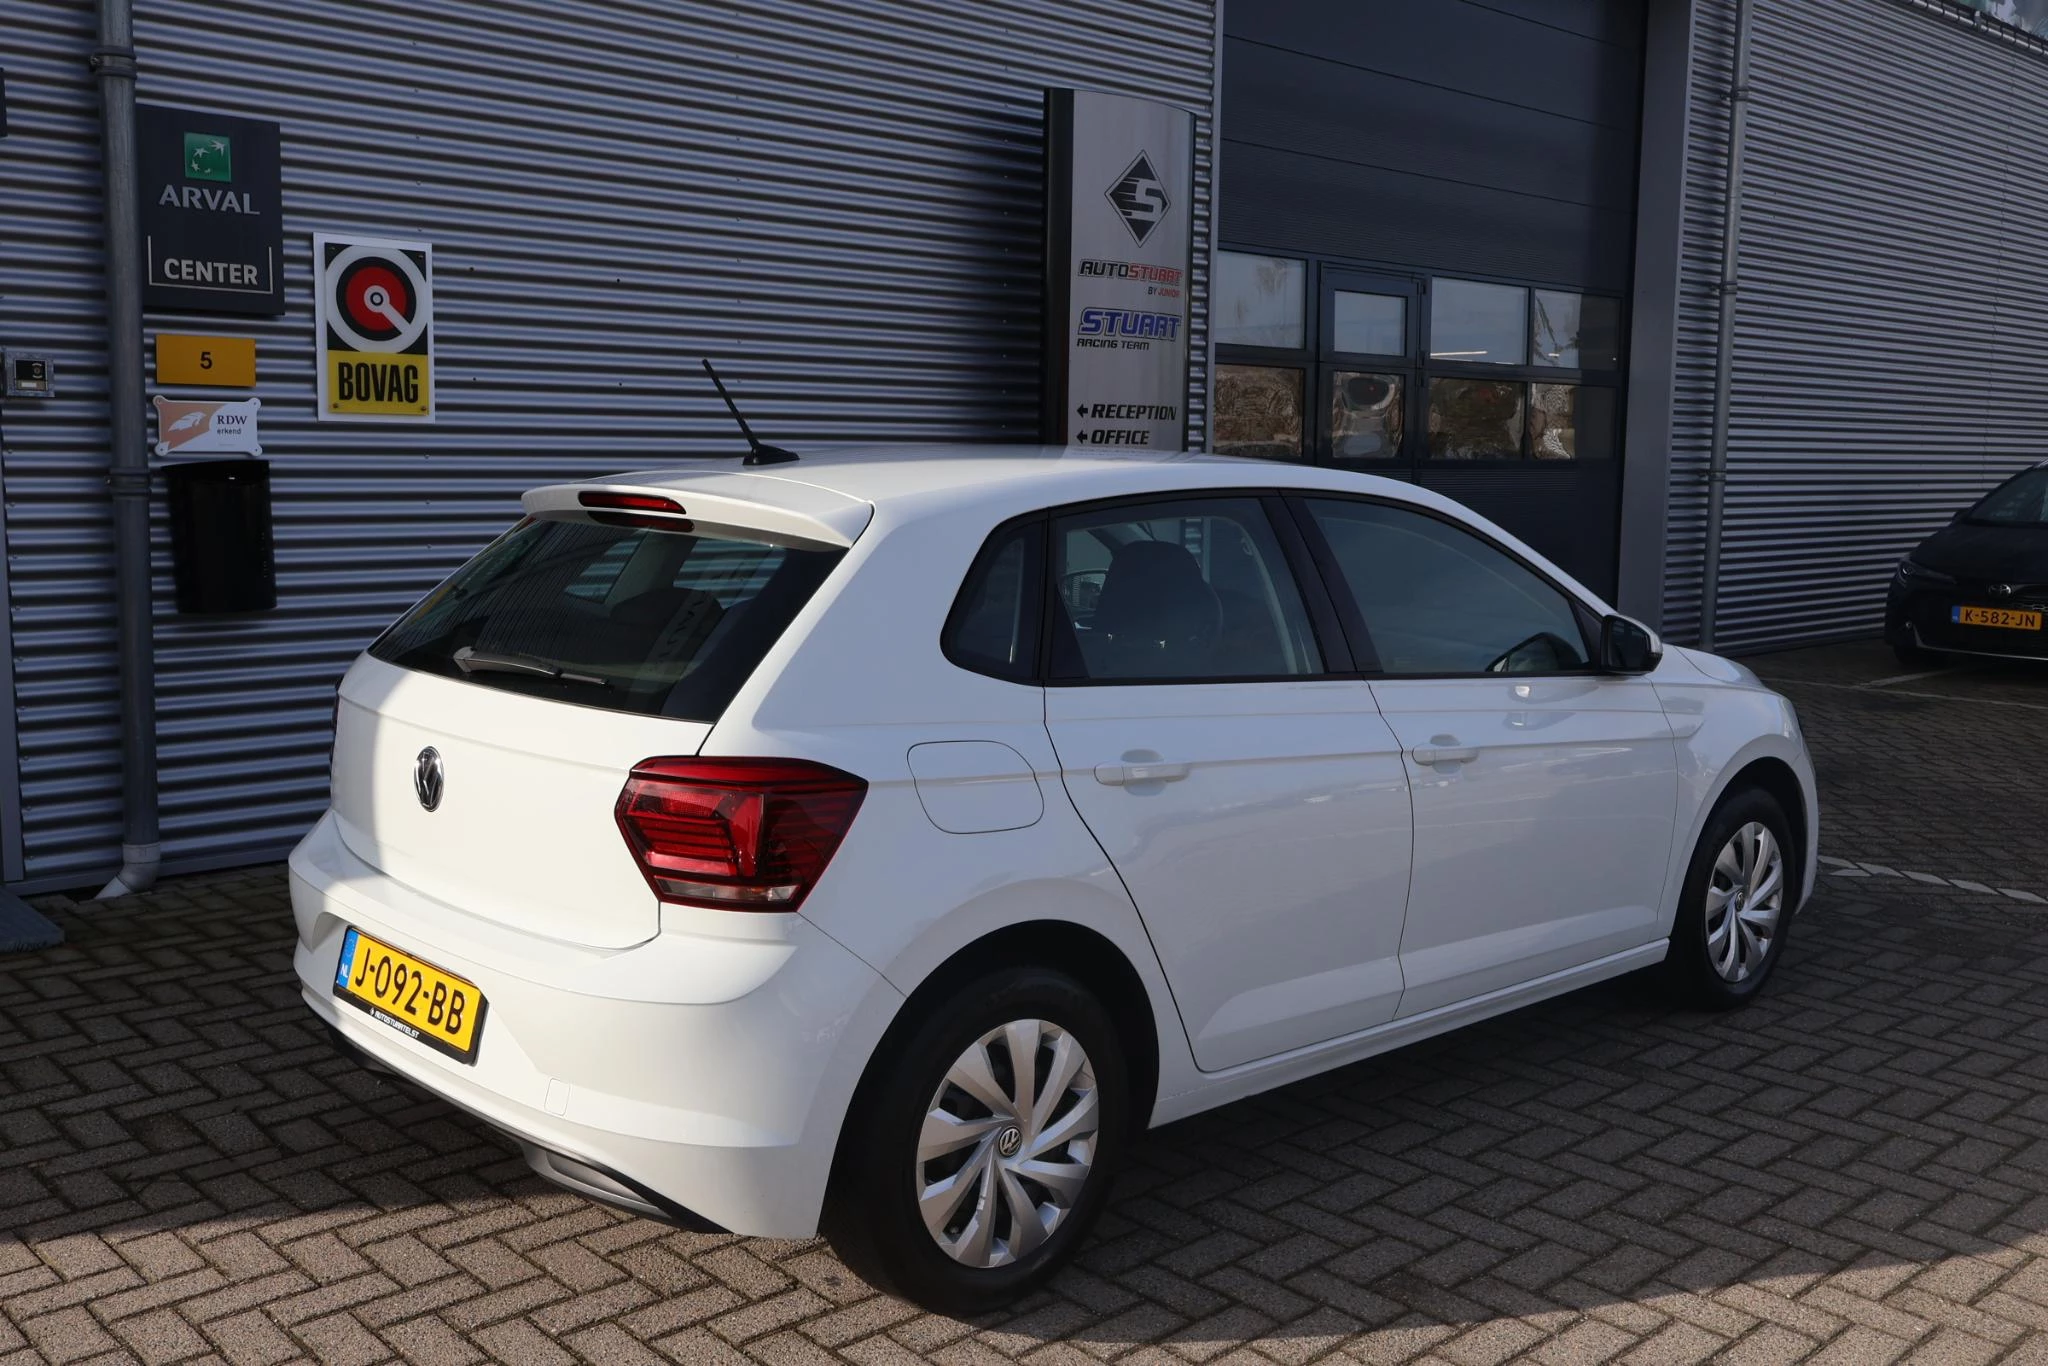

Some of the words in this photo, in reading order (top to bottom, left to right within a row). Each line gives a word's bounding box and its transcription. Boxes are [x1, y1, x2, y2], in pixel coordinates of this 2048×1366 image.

[158, 184, 260, 215] ARVAL
[163, 258, 258, 286] CENTER
[1080, 260, 1182, 283] AUTOSTUART
[1147, 287, 1158, 296] BY
[1079, 308, 1181, 341] STUART
[1077, 339, 1118, 350] RACING
[1120, 340, 1150, 350] TEAM
[200, 352, 212, 369] 5
[338, 362, 419, 403] BOVAG
[217, 415, 247, 424] RDW
[1091, 404, 1176, 420] RECEPTION
[1091, 429, 1150, 445] OFFICE
[1965, 609, 2035, 627] K-582-JN
[340, 963, 349, 978] NL
[355, 947, 465, 1035] J-092-BB
